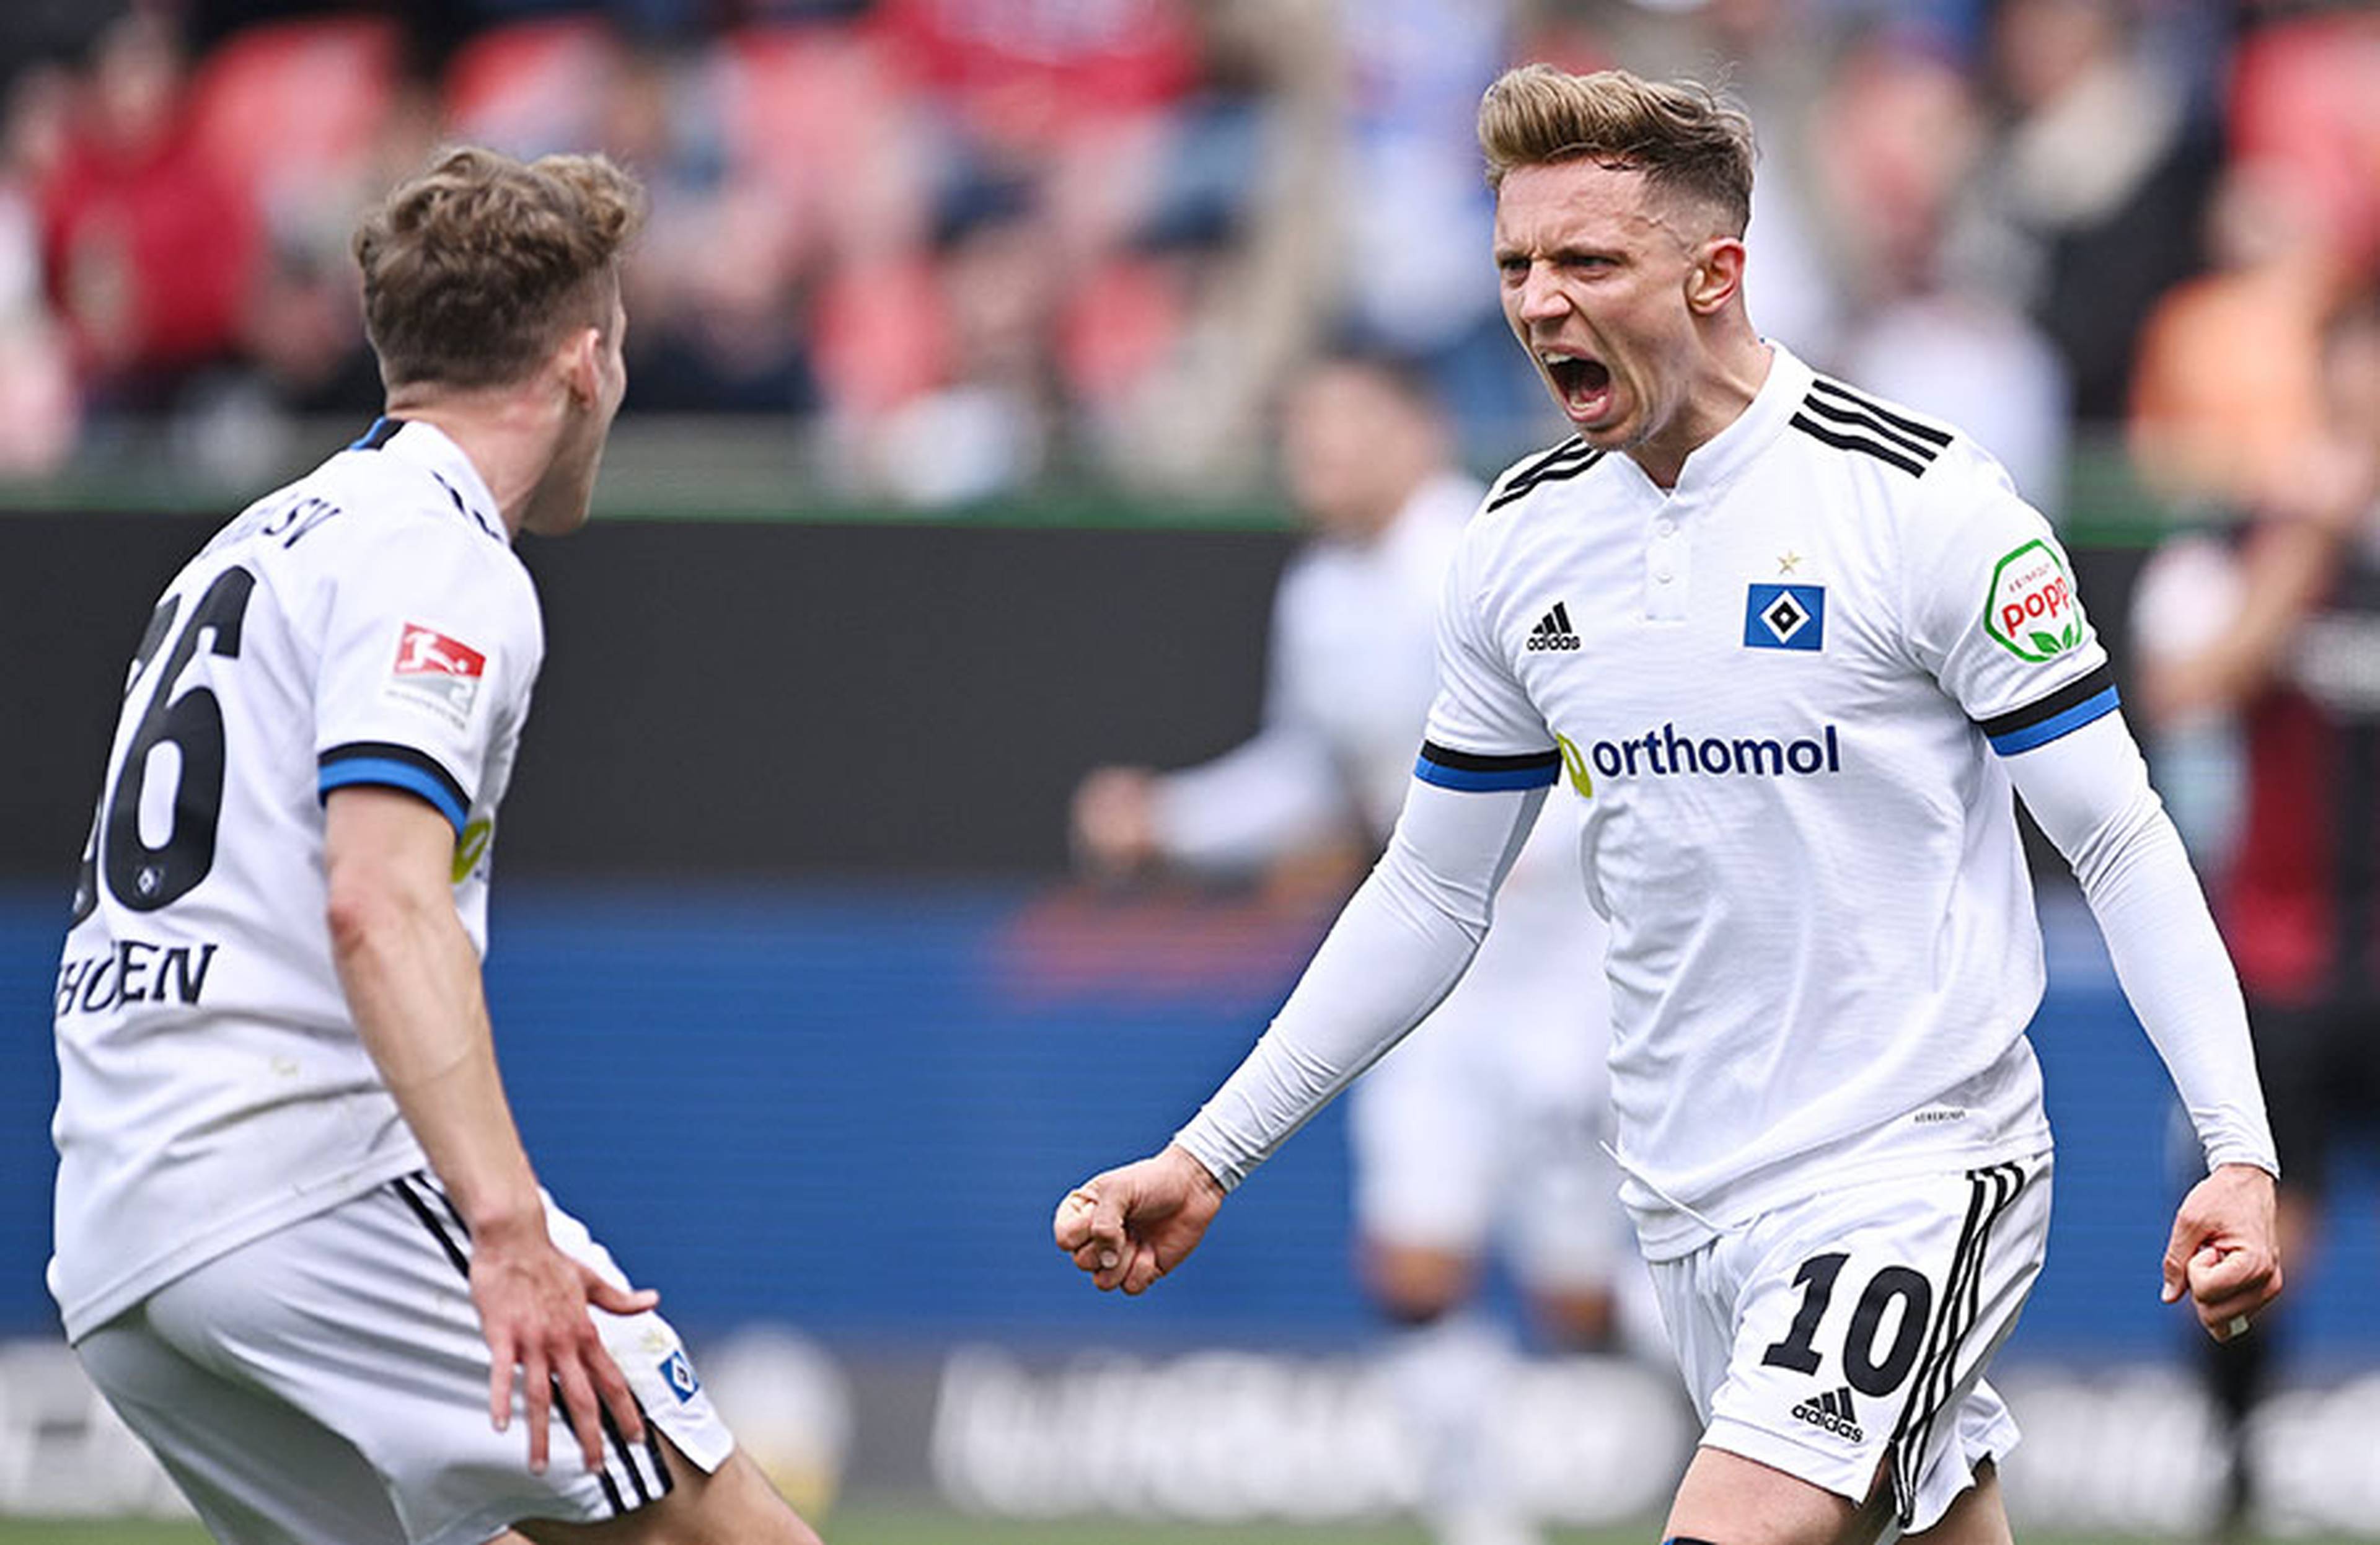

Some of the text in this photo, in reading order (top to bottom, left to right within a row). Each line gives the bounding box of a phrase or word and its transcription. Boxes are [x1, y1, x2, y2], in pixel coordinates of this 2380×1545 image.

[2002, 576, 2069, 638] popp
[1526, 632, 1580, 651] adidas
[1592, 721, 1840, 777] orthomol
[1761, 1252, 1932, 1398] 10
[1791, 1404, 1863, 1443] adidas
